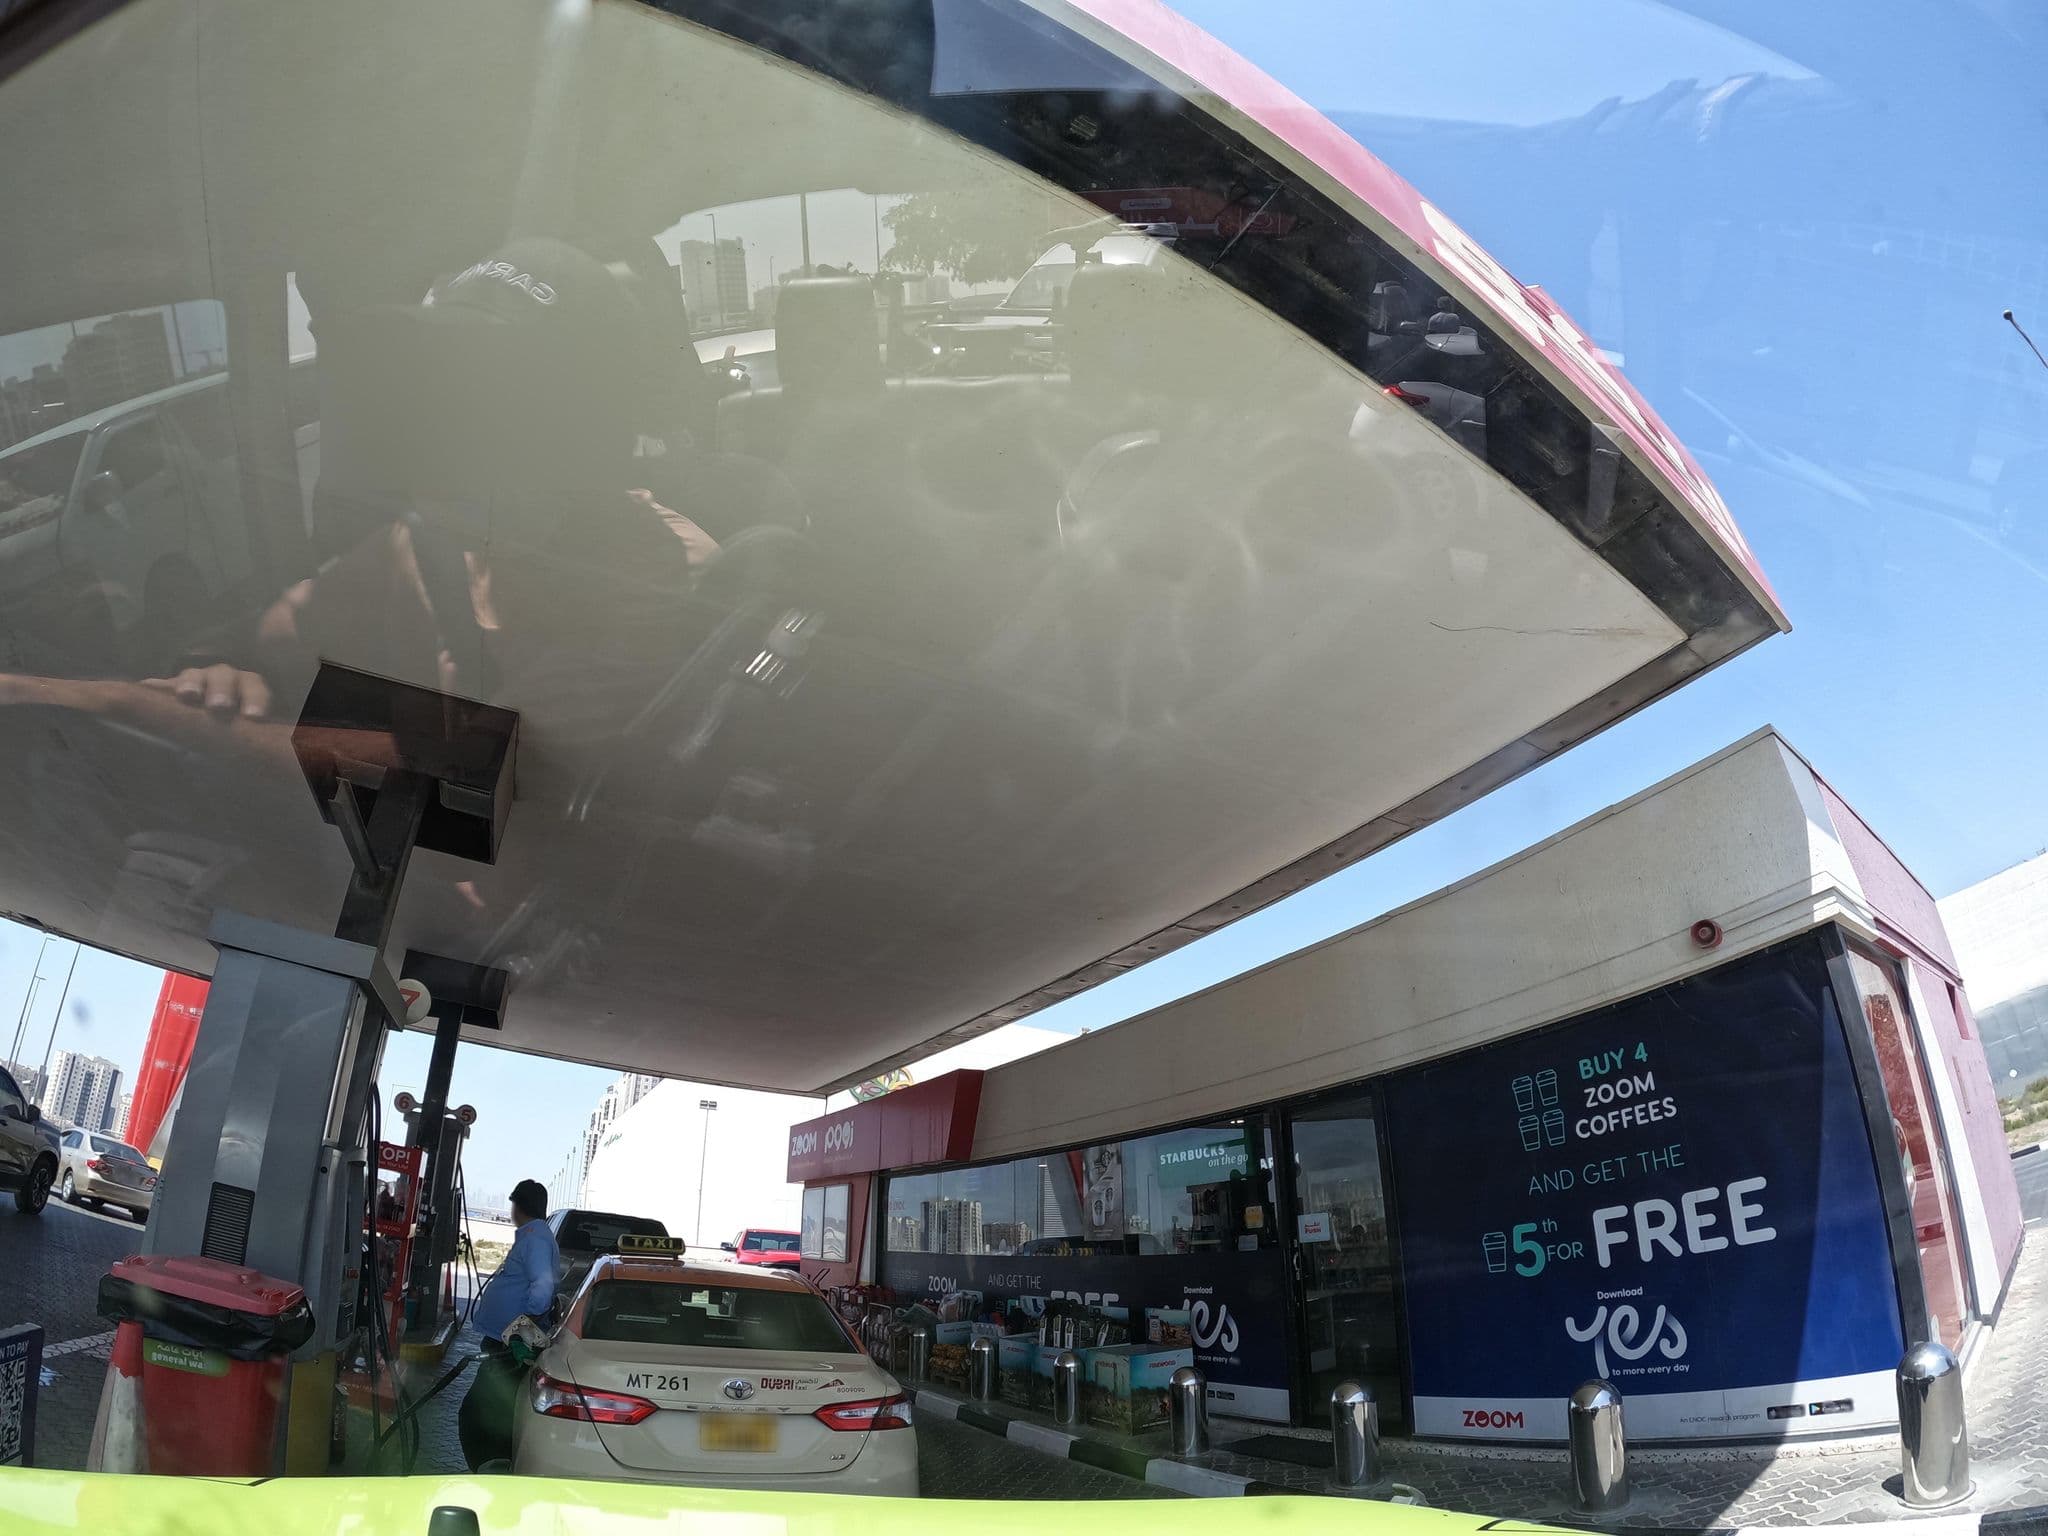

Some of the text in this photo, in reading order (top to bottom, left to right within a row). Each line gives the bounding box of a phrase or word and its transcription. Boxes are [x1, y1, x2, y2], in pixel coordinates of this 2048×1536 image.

[1578, 1041, 1648, 1081] BUY 4
[1584, 1071, 1656, 1108] ZOOM
[461, 1109, 472, 1121] 5
[1575, 1097, 1678, 1139] COFFEES
[792, 1131, 817, 1156] ZOOM
[380, 1146, 411, 1164] OP!
[1160, 1145, 1225, 1165] STARBUCKS
[1208, 1158, 1220, 1168] on
[1221, 1154, 1236, 1165] the
[1236, 1153, 1249, 1165] go
[1528, 1144, 1685, 1196] AND GET THE
[1547, 1241, 1584, 1262] FOR
[1593, 1176, 1777, 1268] FREE
[634, 1237, 673, 1248] TAXI
[928, 1275, 957, 1292] ZOOM
[987, 1274, 1041, 1289] AND GET THE
[1184, 1286, 1213, 1294] Download
[1597, 1286, 1643, 1300] Download
[1182, 1299, 1239, 1353] es
[6, 1344, 16, 1358] TO
[16, 1340, 29, 1354] PAY
[1565, 1304, 1688, 1379] yes
[151, 1352, 187, 1365] general
[1612, 1363, 1690, 1377] to more every day
[626, 1373, 689, 1391] MT 261
[761, 1377, 794, 1390] DUBAI
[1462, 1409, 1524, 1429] ZOOM
